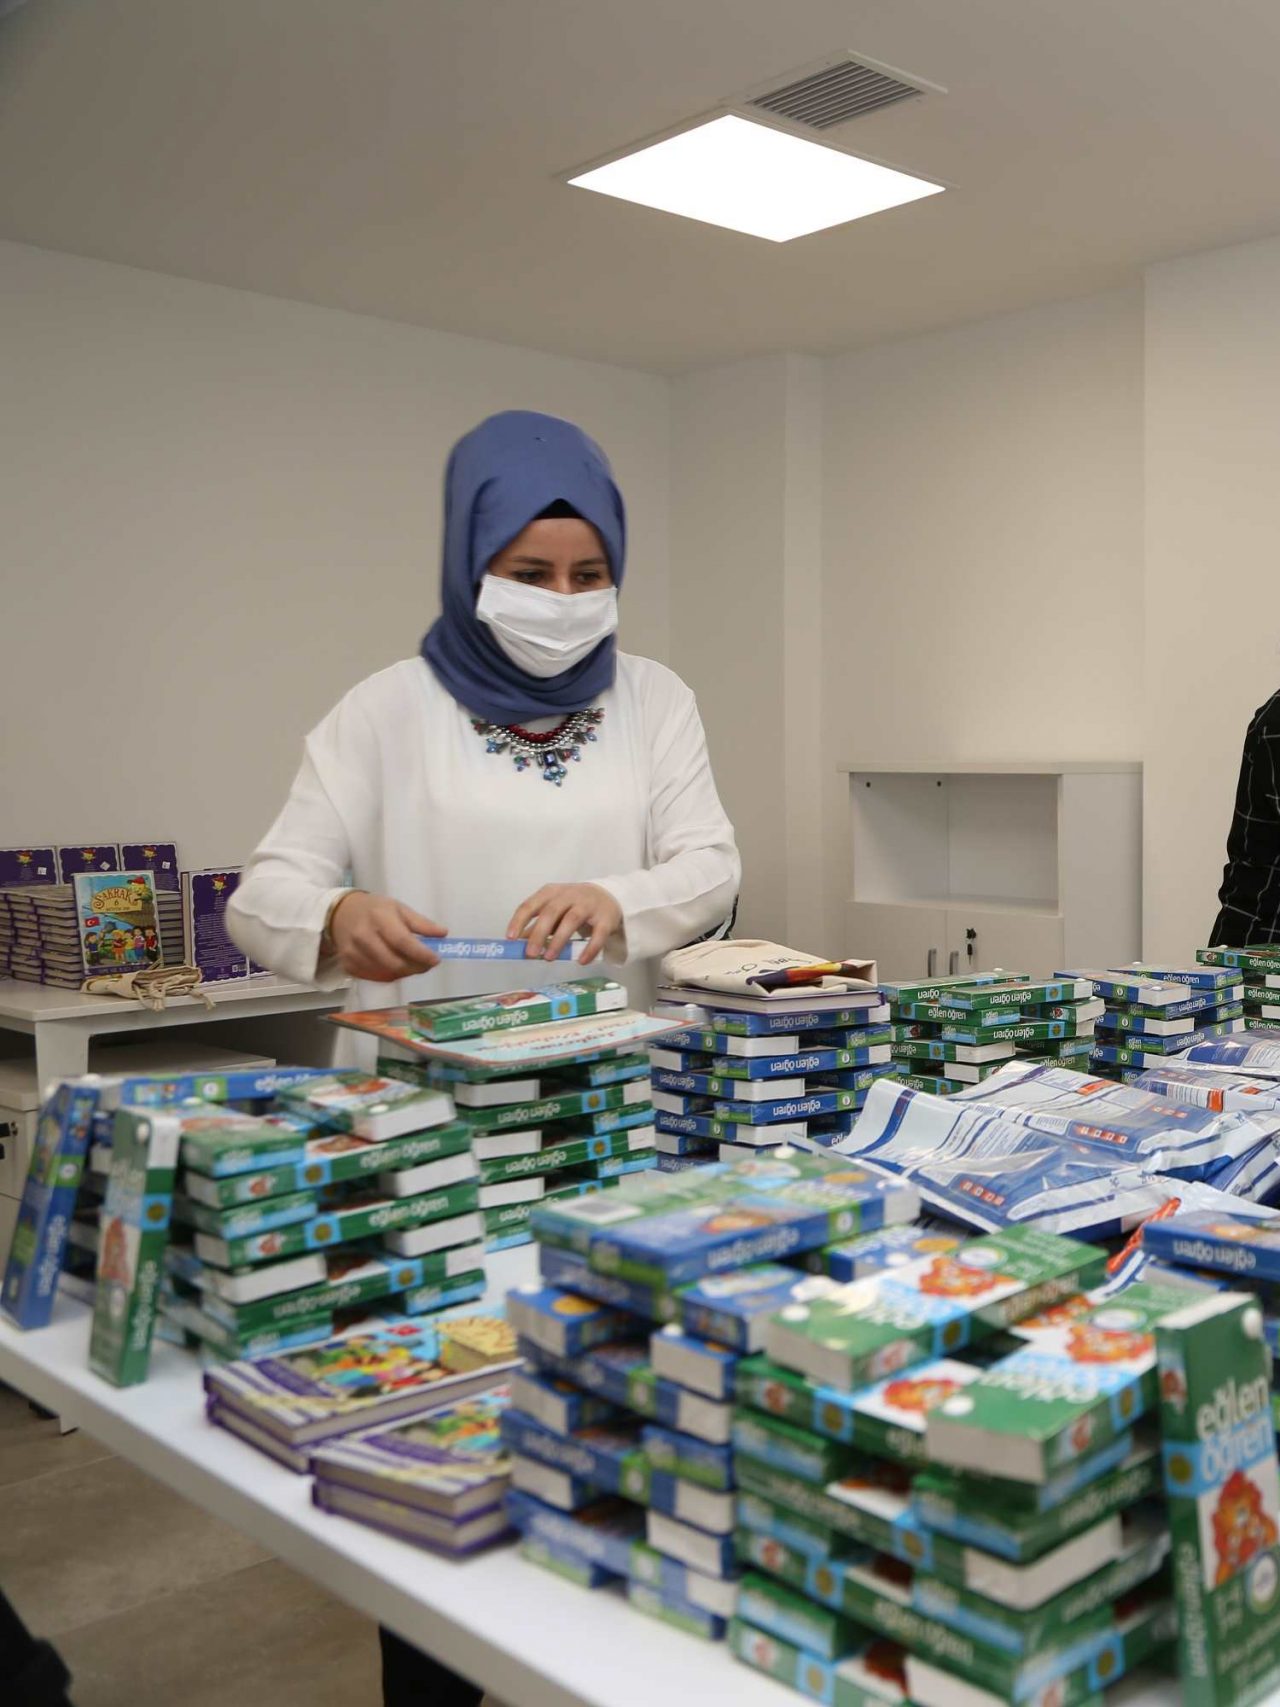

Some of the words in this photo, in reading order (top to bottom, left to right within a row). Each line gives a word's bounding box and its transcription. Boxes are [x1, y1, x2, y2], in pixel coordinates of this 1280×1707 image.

[1249, 958, 1266, 968] eğlen
[1181, 974, 1200, 985] öğren
[990, 994, 1011, 1004] öğren
[1012, 991, 1032, 1005] eğlen
[1248, 989, 1264, 998] eğlen
[497, 1010, 529, 1028] eğlen
[928, 1006, 947, 1019] eğlen
[947, 1009, 967, 1021] öğren
[462, 1015, 495, 1031] öğren
[994, 1029, 1014, 1040] öğren
[1014, 1027, 1035, 1041] eğlen
[771, 1059, 795, 1073] öğren
[795, 1056, 820, 1072] eğlen
[773, 1102, 797, 1117] öğren
[797, 1099, 821, 1115] eğlen
[1196, 1377, 1269, 1439] eğlen
